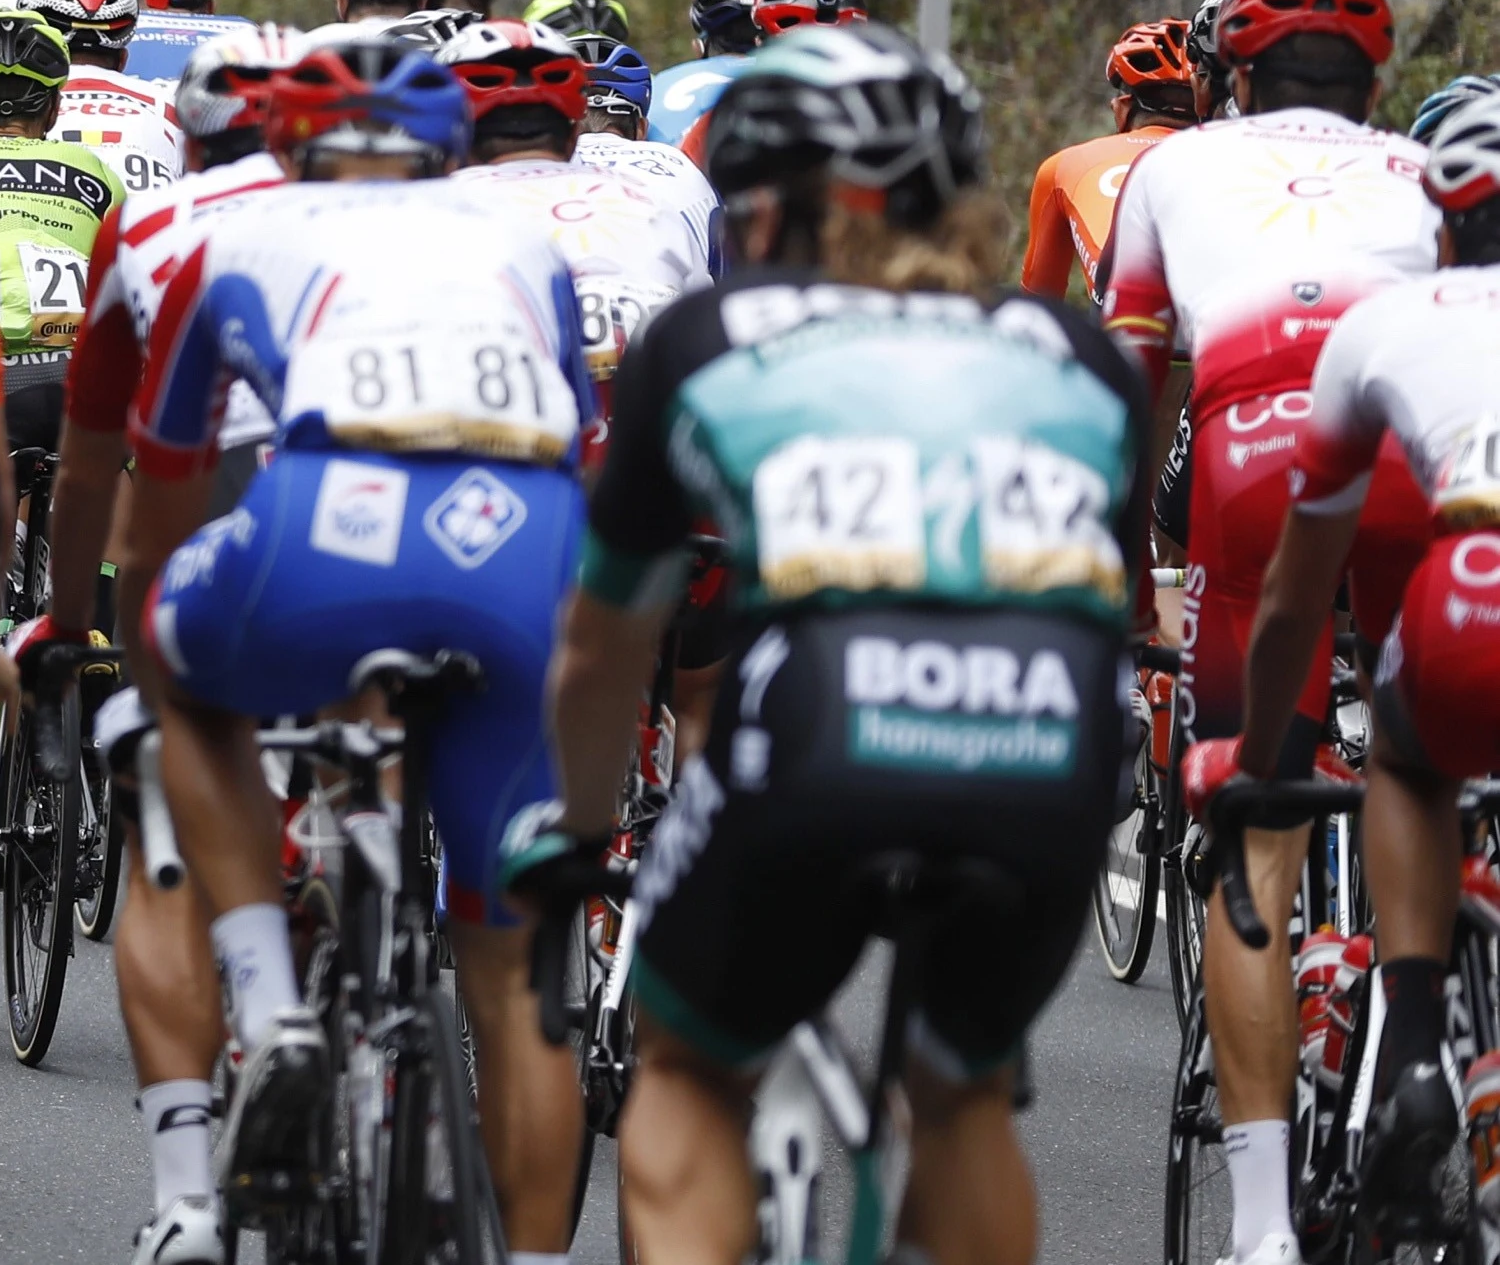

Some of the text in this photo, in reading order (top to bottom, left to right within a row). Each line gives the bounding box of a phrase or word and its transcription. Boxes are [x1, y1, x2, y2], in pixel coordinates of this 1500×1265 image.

[34, 257, 87, 308] 21
[348, 346, 422, 411] 81
[474, 344, 544, 419] 81
[843, 636, 1080, 719] BORA
[856, 709, 1072, 773] hansgrohe
